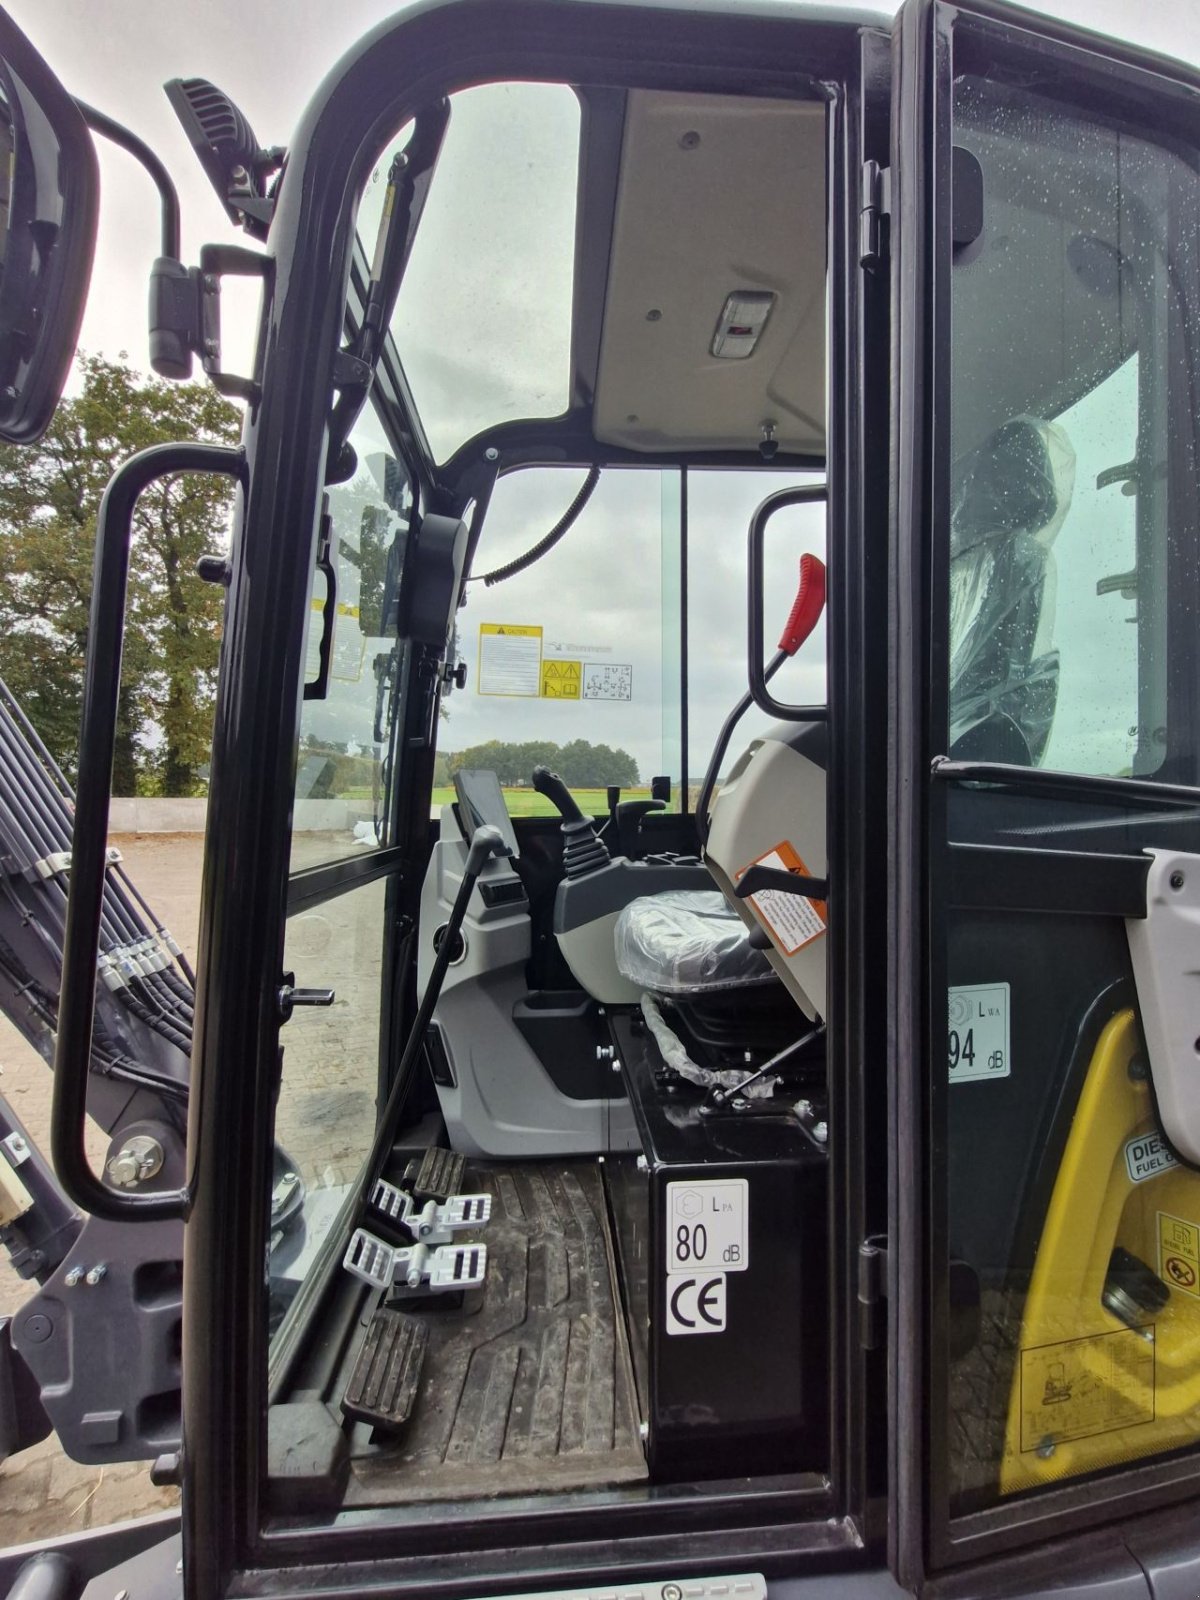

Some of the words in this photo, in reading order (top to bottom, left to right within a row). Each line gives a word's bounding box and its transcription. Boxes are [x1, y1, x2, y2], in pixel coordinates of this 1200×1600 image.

[948, 1028, 976, 1069] 94
[988, 1050, 1004, 1070] dB
[1136, 1157, 1164, 1175] FUEL
[676, 1223, 707, 1262] 80
[722, 1244, 741, 1263] dB
[670, 1277, 723, 1328] CE
